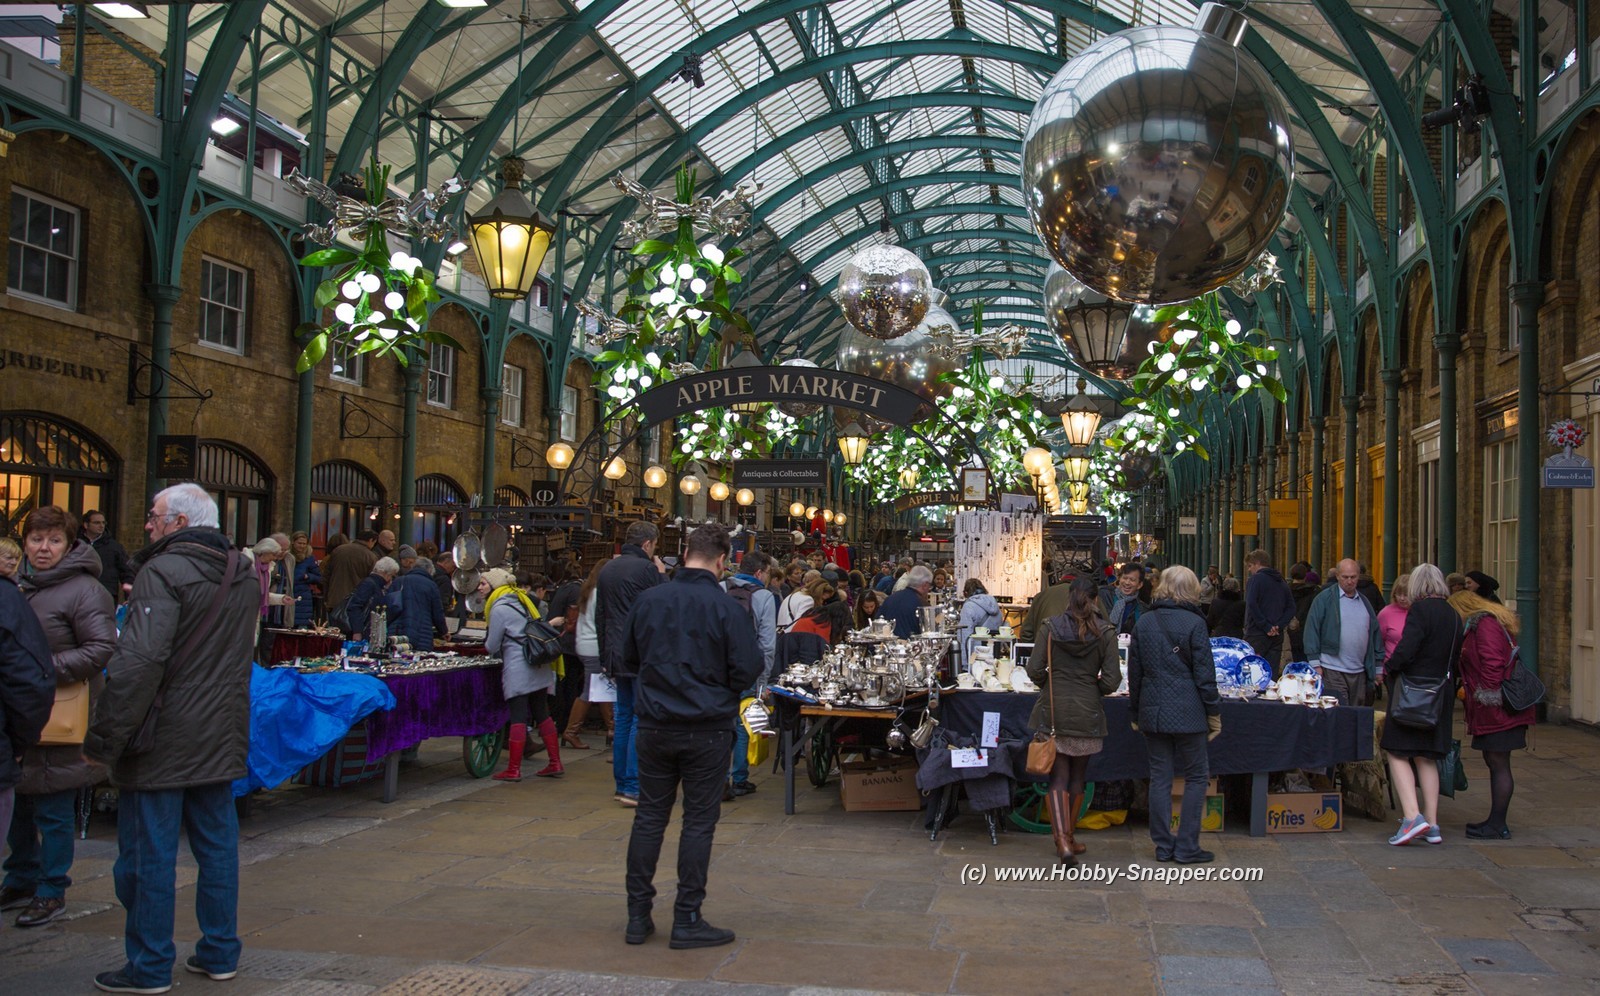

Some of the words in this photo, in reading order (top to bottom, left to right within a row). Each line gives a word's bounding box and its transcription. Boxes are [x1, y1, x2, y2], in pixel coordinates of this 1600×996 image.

[676, 375, 754, 407] APPLE
[769, 374, 887, 408] MARKET
[741, 470, 772, 479] Antiques
[779, 470, 819, 478] Collectables
[908, 493, 942, 506] APPLE
[862, 775, 903, 786] BANANAS
